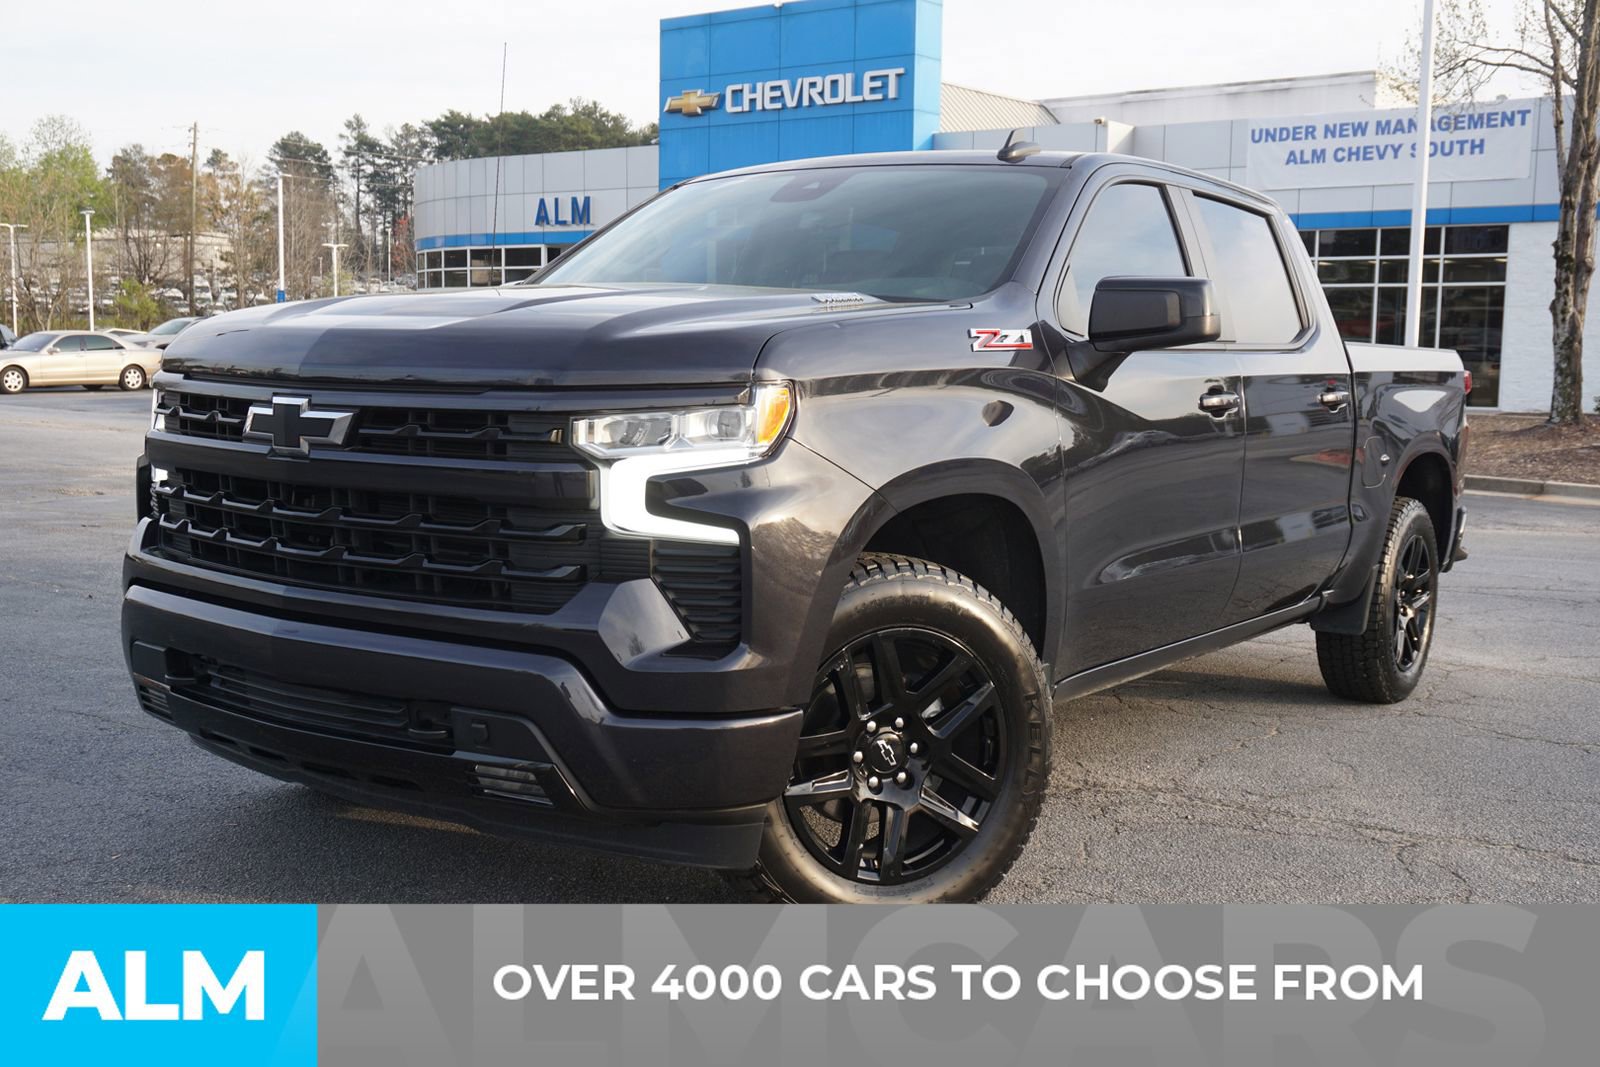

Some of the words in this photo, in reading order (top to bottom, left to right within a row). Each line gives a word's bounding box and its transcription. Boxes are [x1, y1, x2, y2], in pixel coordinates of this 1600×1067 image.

[725, 67, 905, 113] CHEVROLET
[1250, 124, 1317, 144] UNDER
[1323, 120, 1369, 139] NEW
[1285, 148, 1327, 165] ALM
[1333, 143, 1404, 162] CHEVY
[535, 195, 591, 226] ALM
